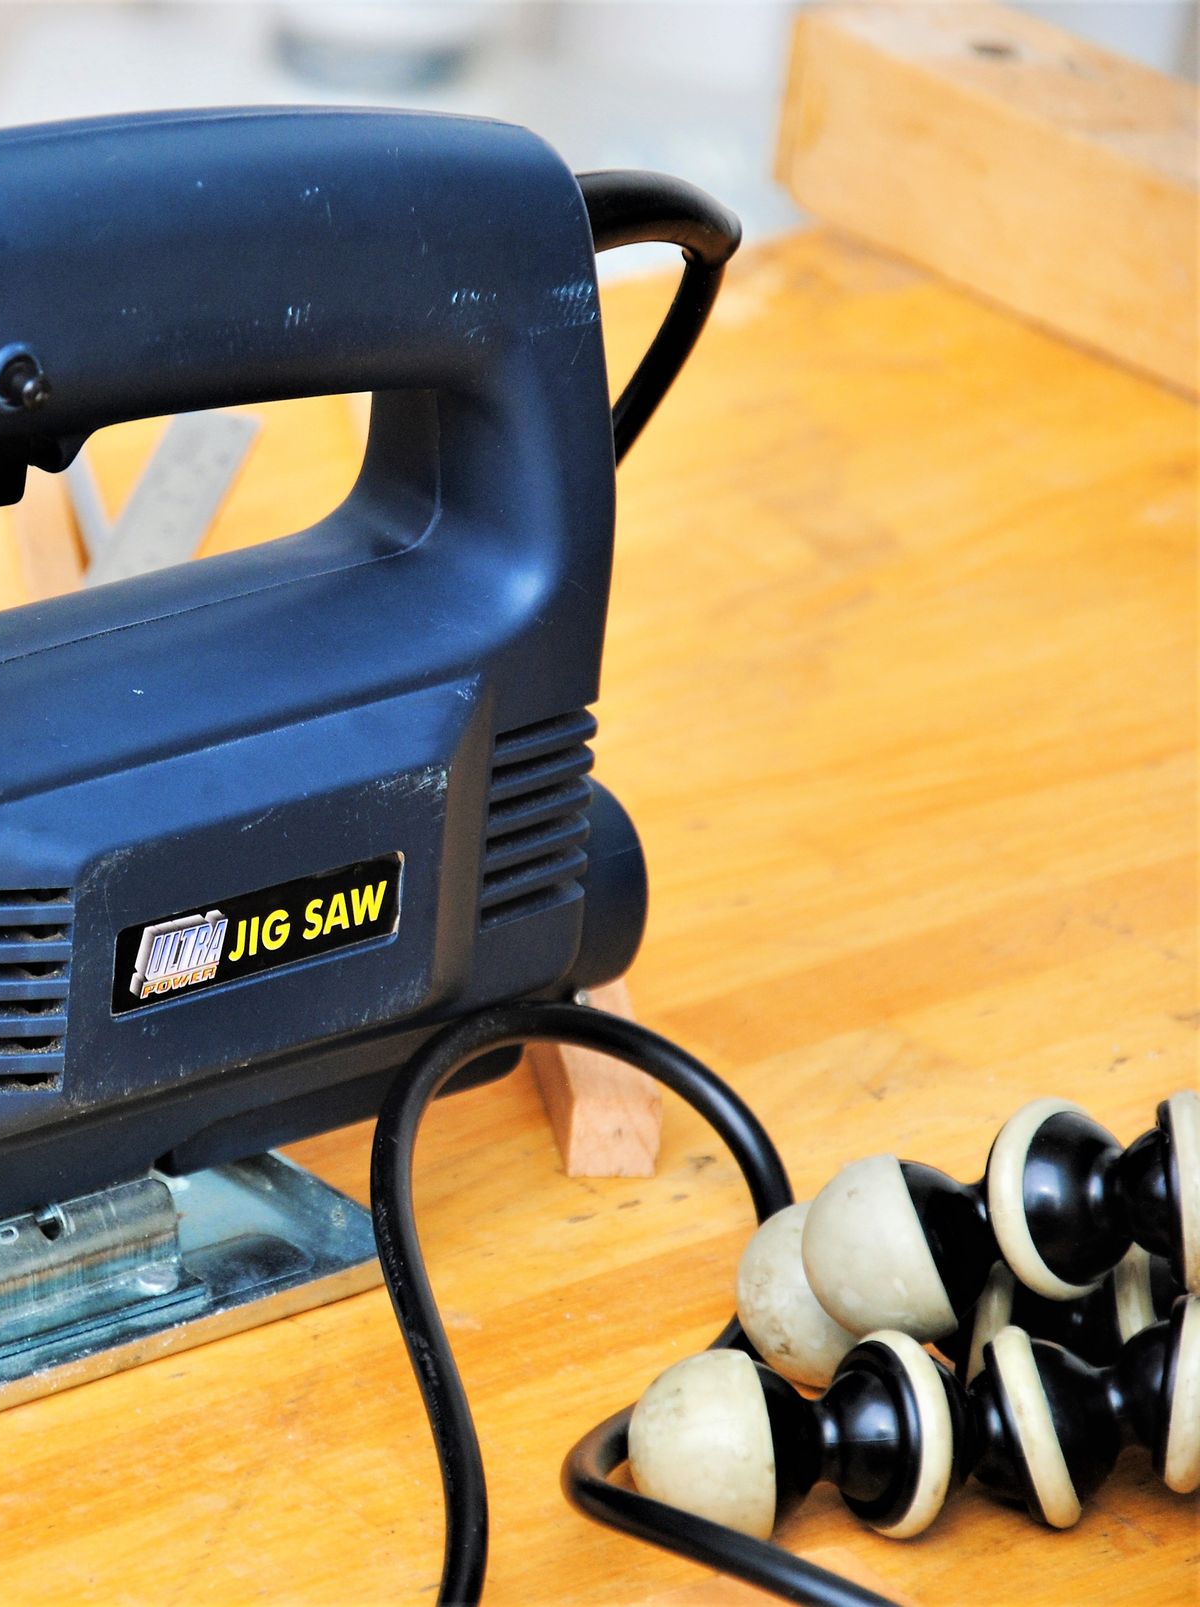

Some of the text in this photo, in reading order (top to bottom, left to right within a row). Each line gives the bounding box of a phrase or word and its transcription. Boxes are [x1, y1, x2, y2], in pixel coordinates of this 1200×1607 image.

[145, 919, 228, 981] ULTRA
[228, 880, 388, 962] JIG SAW
[140, 965, 217, 999] POWER
